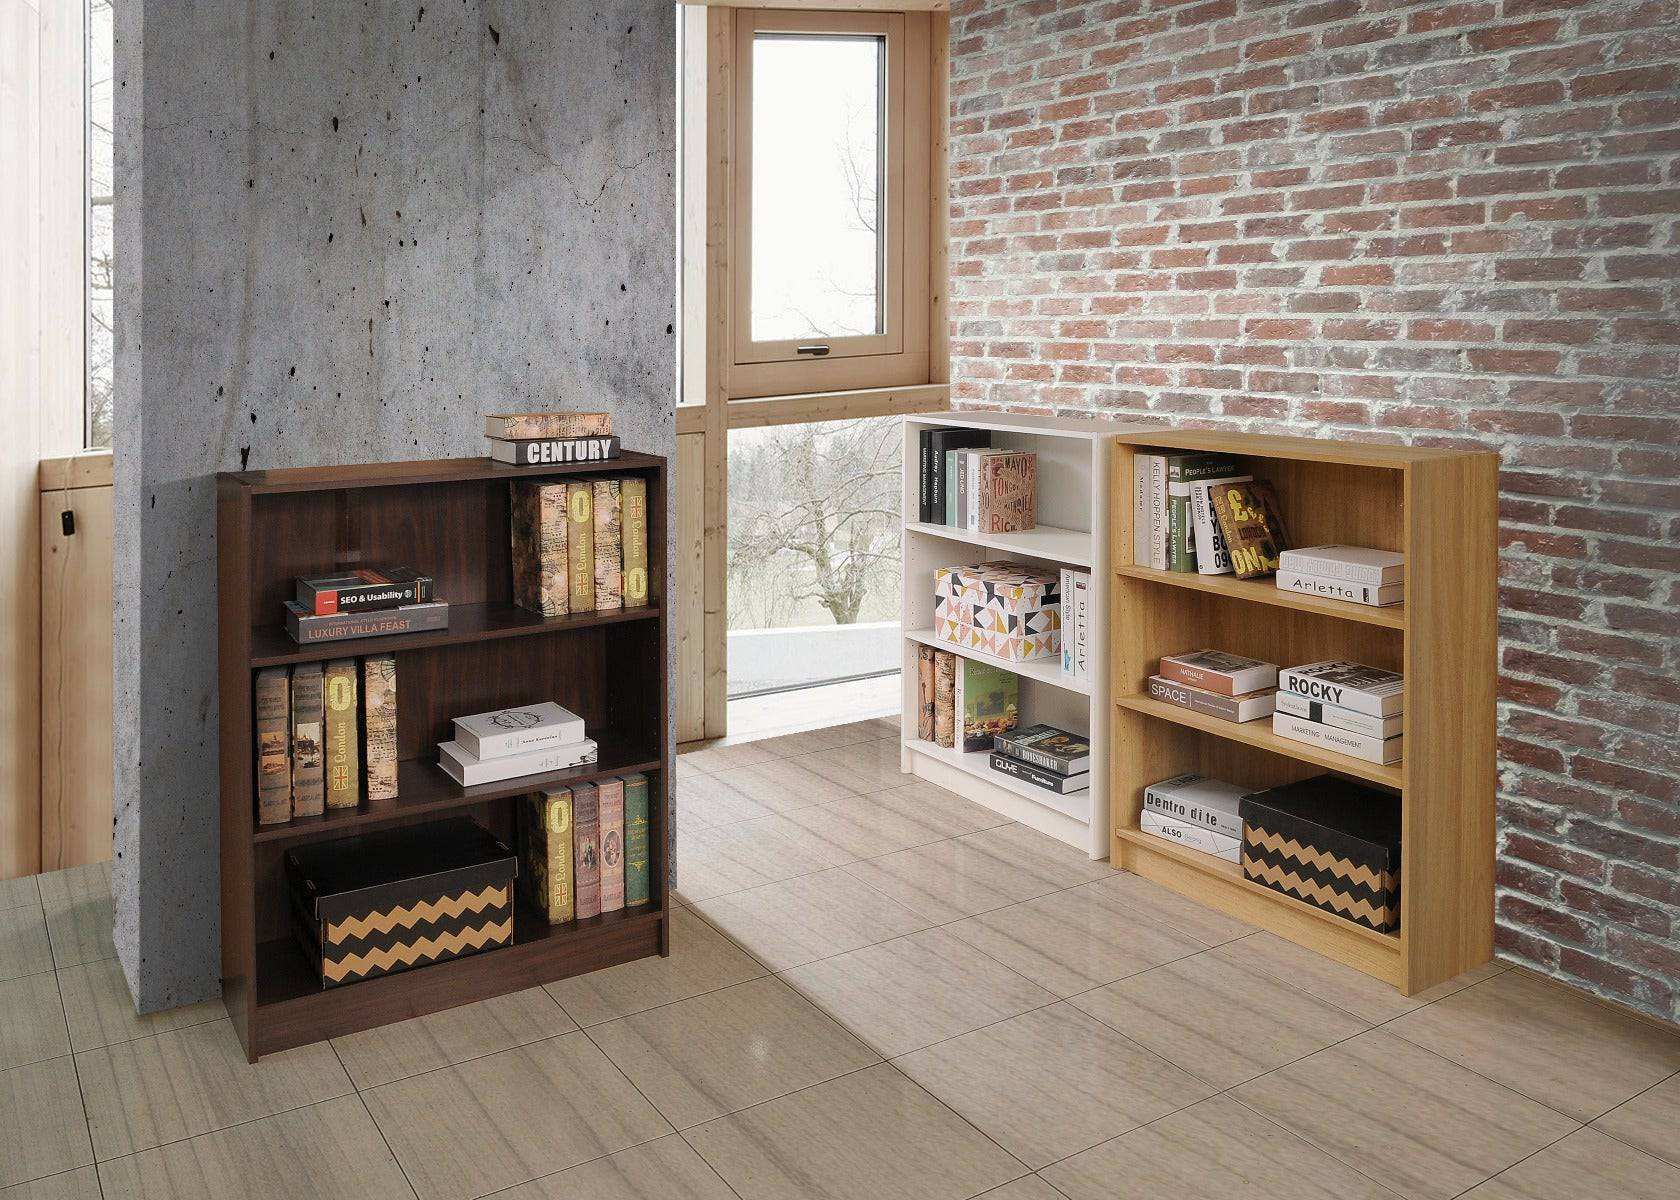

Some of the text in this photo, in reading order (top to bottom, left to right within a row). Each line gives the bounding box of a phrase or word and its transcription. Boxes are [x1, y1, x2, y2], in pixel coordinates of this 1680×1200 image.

[526, 439, 612, 464] CENTURY
[340, 595, 358, 605] SEO
[359, 594, 366, 603] &
[367, 590, 403, 602] Usability
[1293, 579, 1354, 598] Arletta
[308, 626, 348, 639] LUXURY
[351, 623, 378, 635] VILLA
[380, 620, 411, 632] FEAST
[1077, 601, 1086, 671] Arletta
[1151, 683, 1187, 704] SPACE
[1288, 675, 1343, 704] ROCKY
[1291, 725, 1362, 748] MARKETING MANAGEMENT
[1146, 792, 1217, 826] Dentro di te
[1161, 826, 1182, 838] ALSO
